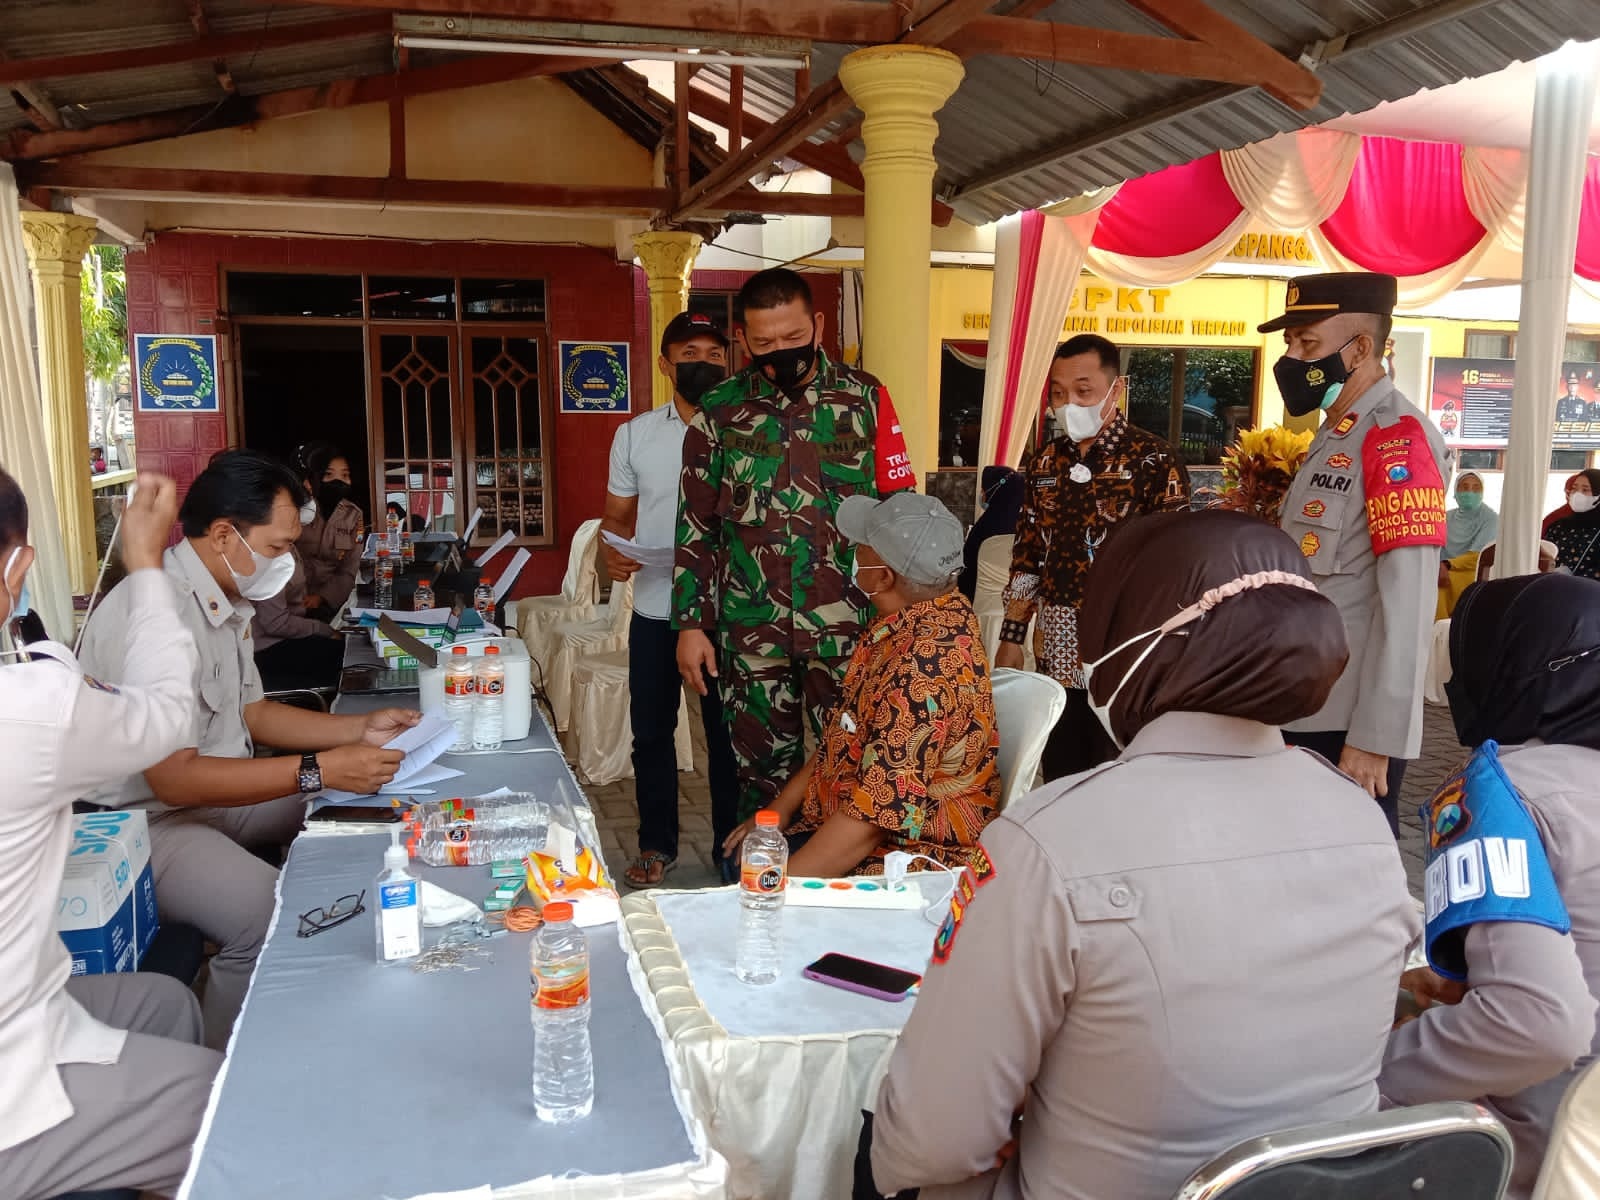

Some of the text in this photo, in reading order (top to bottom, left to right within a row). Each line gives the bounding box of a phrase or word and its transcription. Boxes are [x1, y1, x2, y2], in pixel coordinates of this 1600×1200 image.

[1227, 233, 1314, 260] GPANGG
[1106, 317, 1185, 335] KEPOLISIAN
[1191, 319, 1247, 336] TERPADU
[1462, 369, 1479, 384] 16
[1309, 473, 1352, 493] POLRI
[1365, 487, 1445, 520] ENGAWAS
[1379, 523, 1436, 542] TNI-POLRI
[763, 875, 779, 886] Cleo
[1425, 837, 1531, 925] ROV
